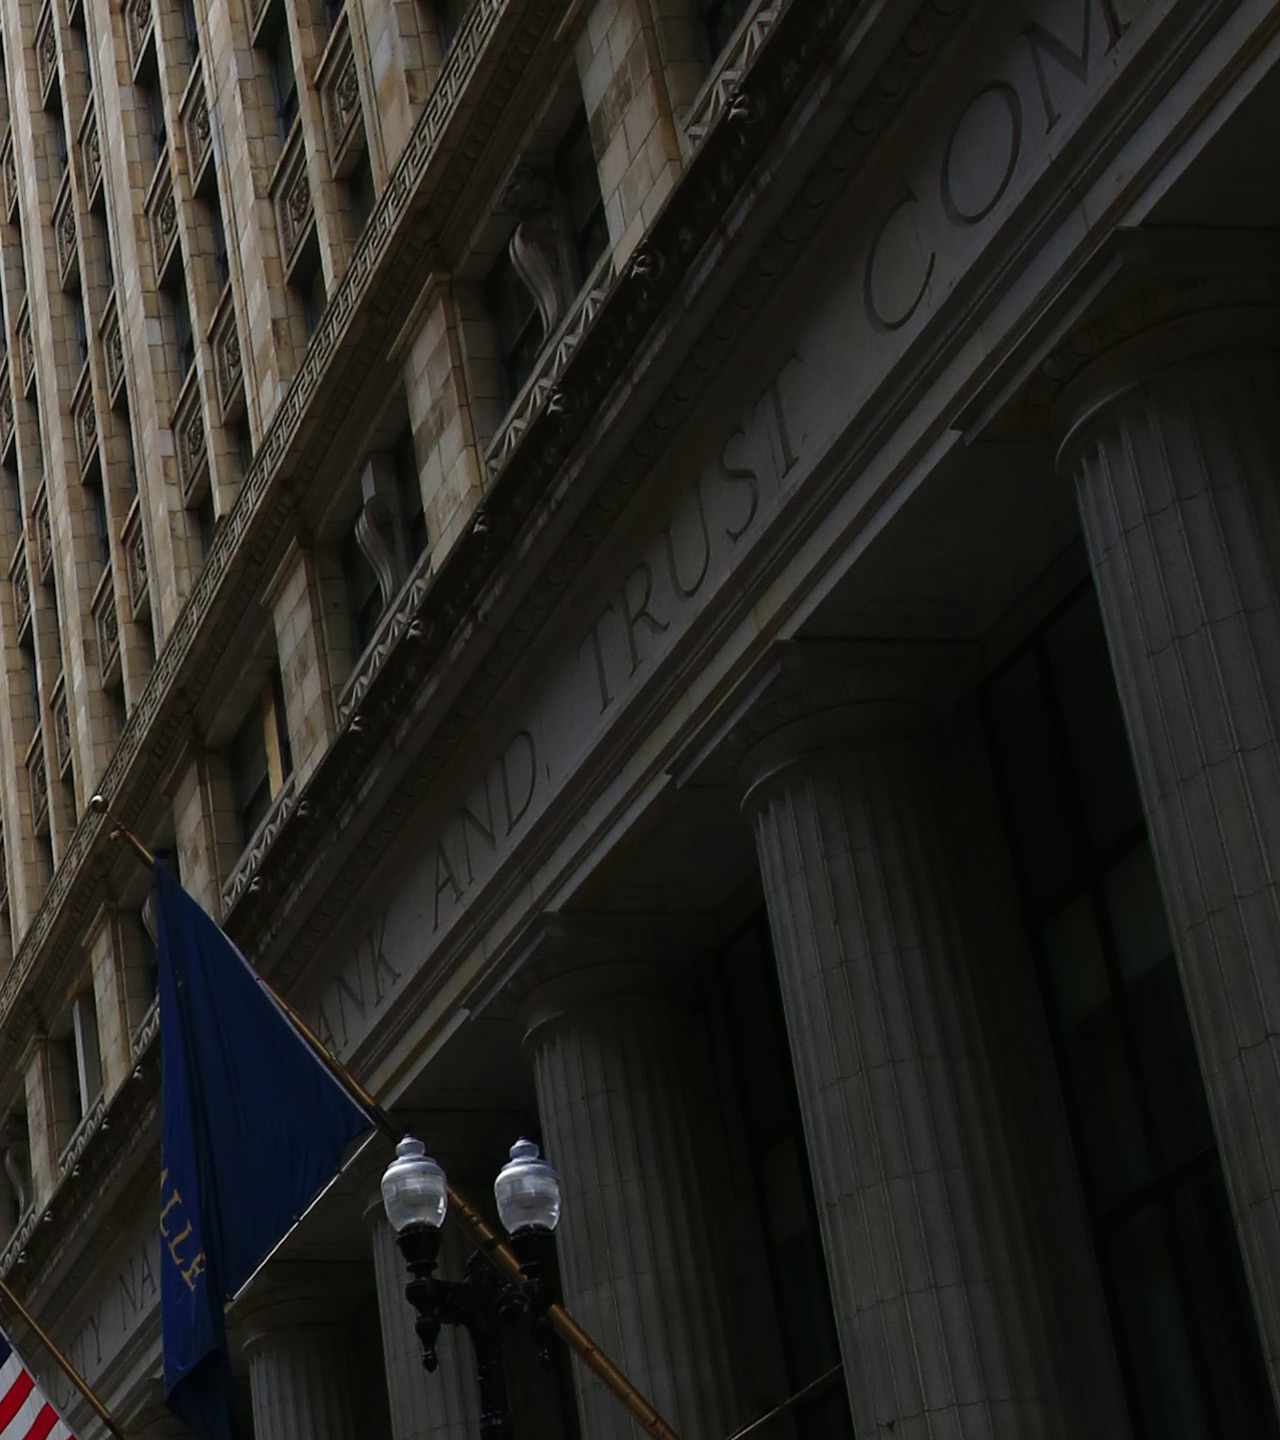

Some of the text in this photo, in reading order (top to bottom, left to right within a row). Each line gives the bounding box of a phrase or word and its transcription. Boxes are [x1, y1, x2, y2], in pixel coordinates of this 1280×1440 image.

[317, 910, 401, 1057] ANK
[432, 728, 538, 933] AND
[577, 345, 801, 714] TRUST
